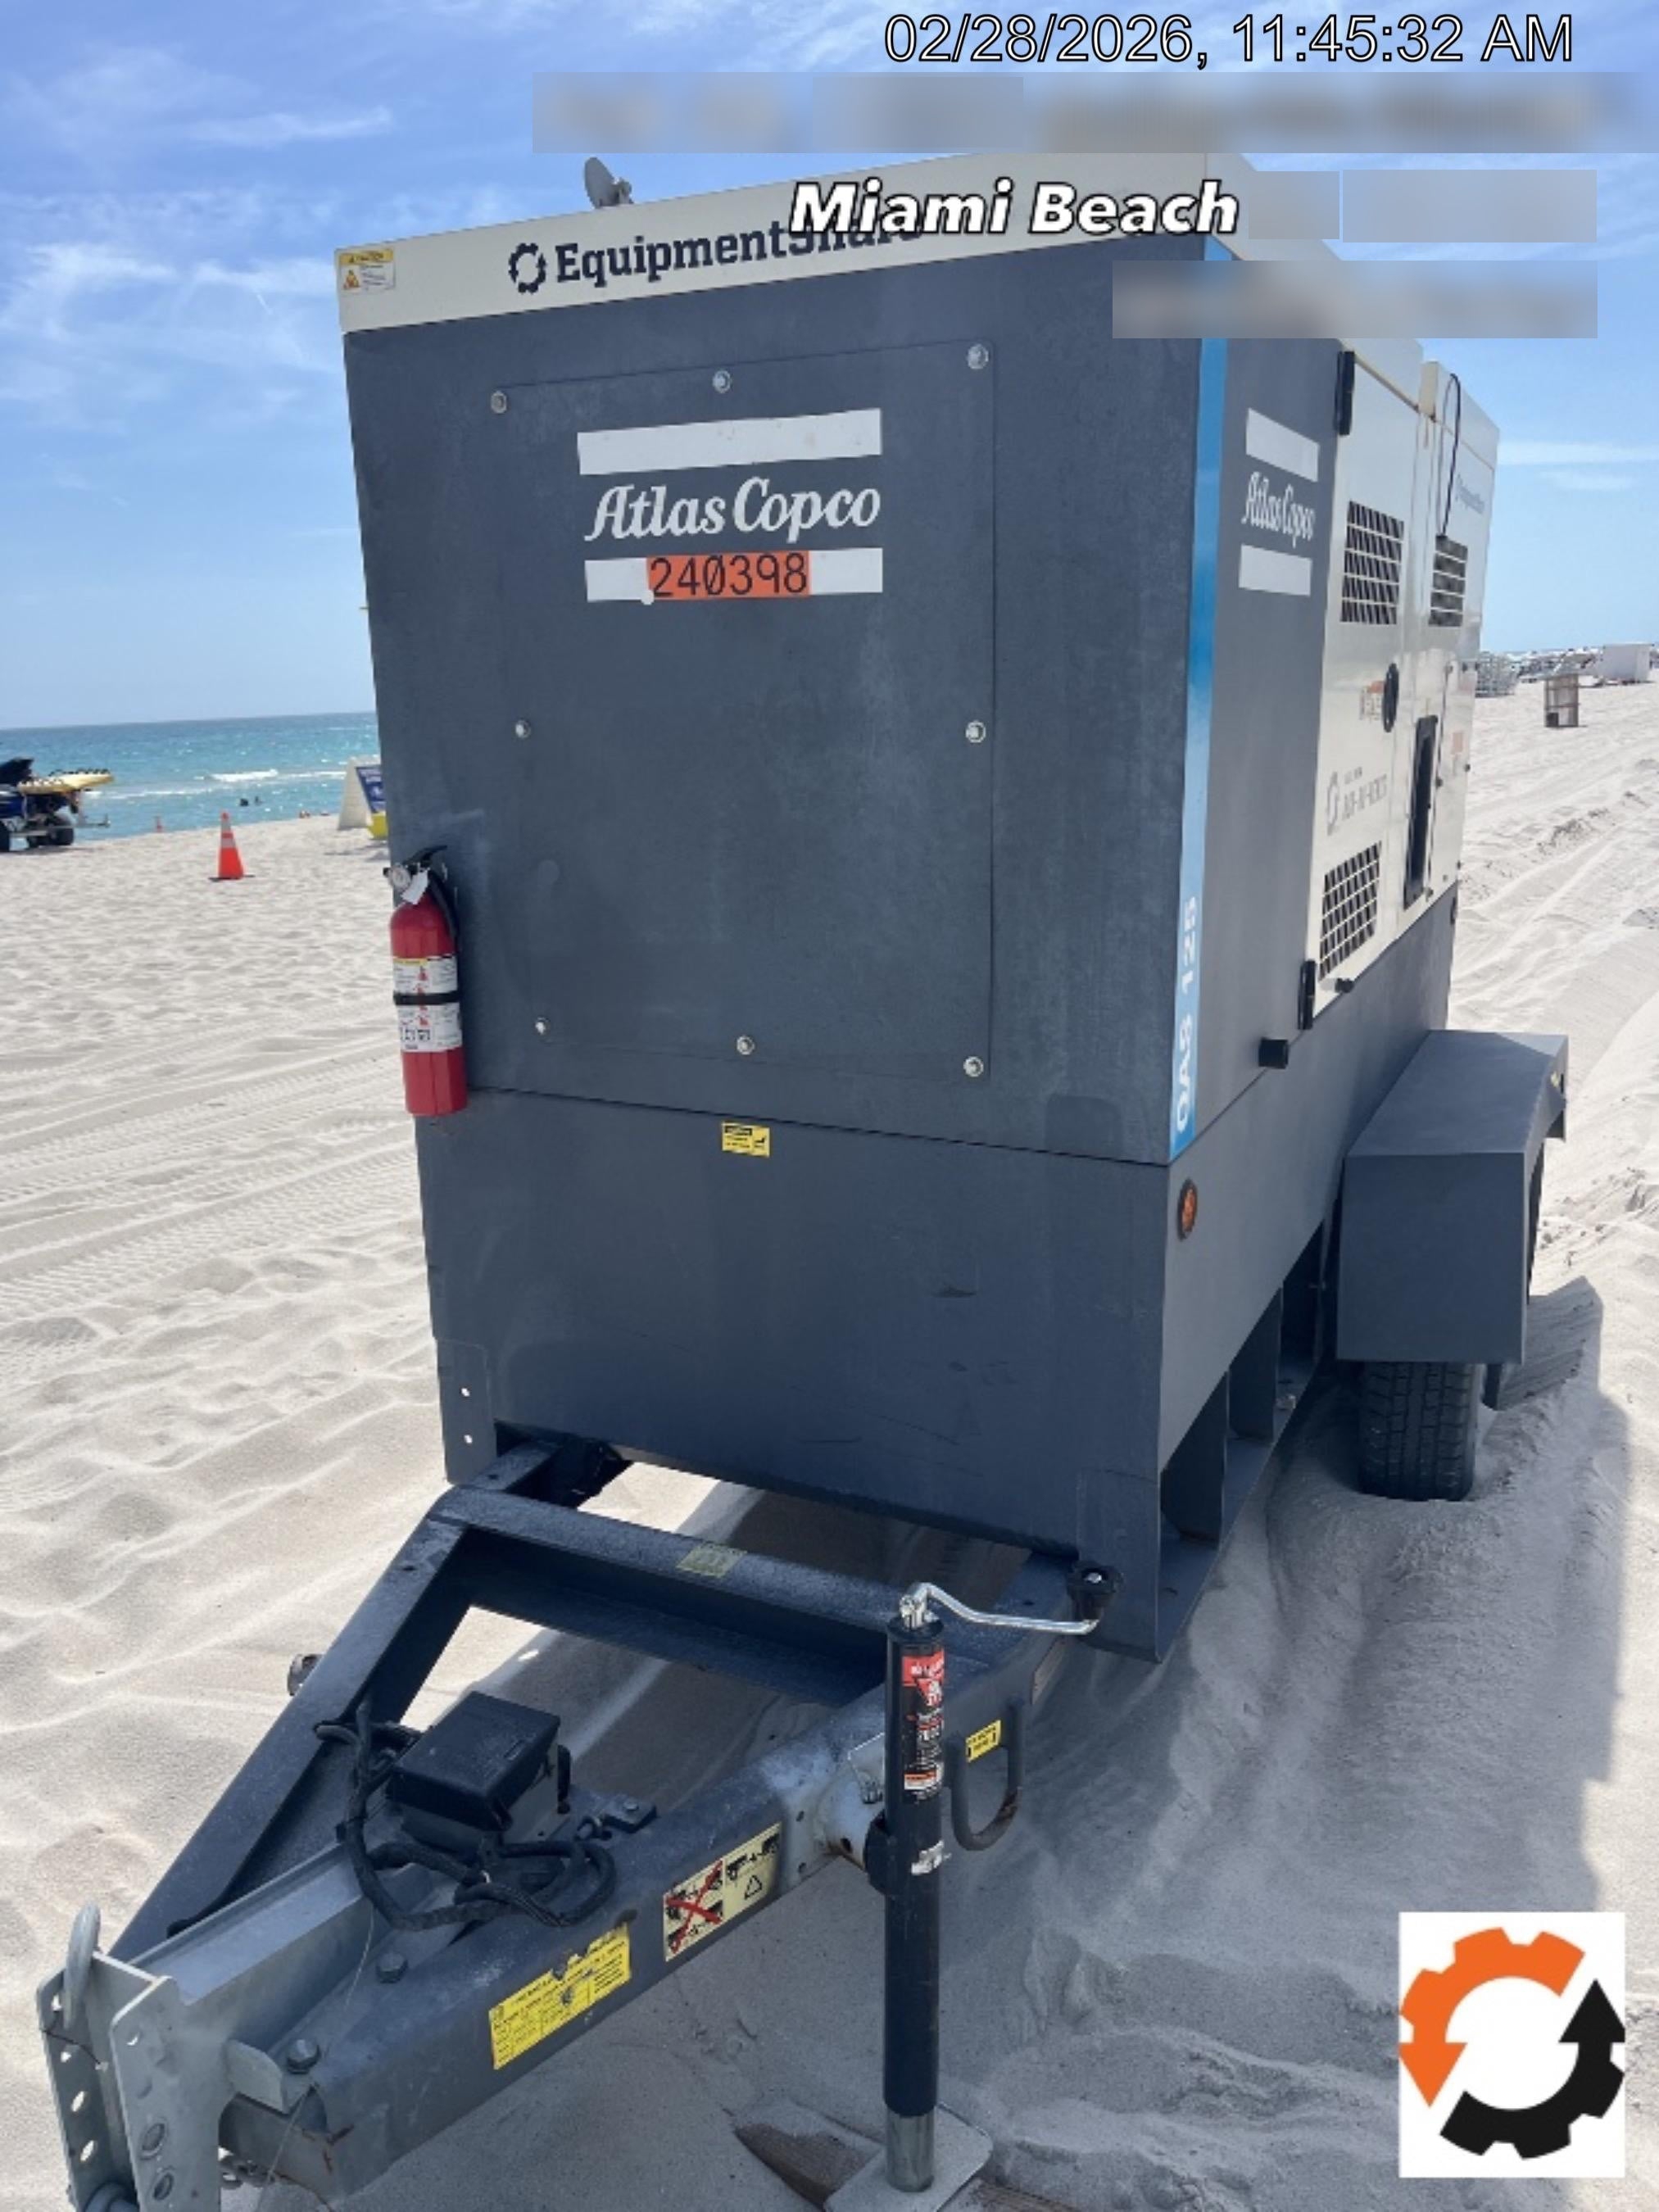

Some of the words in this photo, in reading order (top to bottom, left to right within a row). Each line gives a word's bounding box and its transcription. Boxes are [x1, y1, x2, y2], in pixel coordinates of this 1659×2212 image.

[584, 483, 726, 542] Atlas
[732, 476, 882, 544] Copco
[650, 551, 807, 597] 240398
